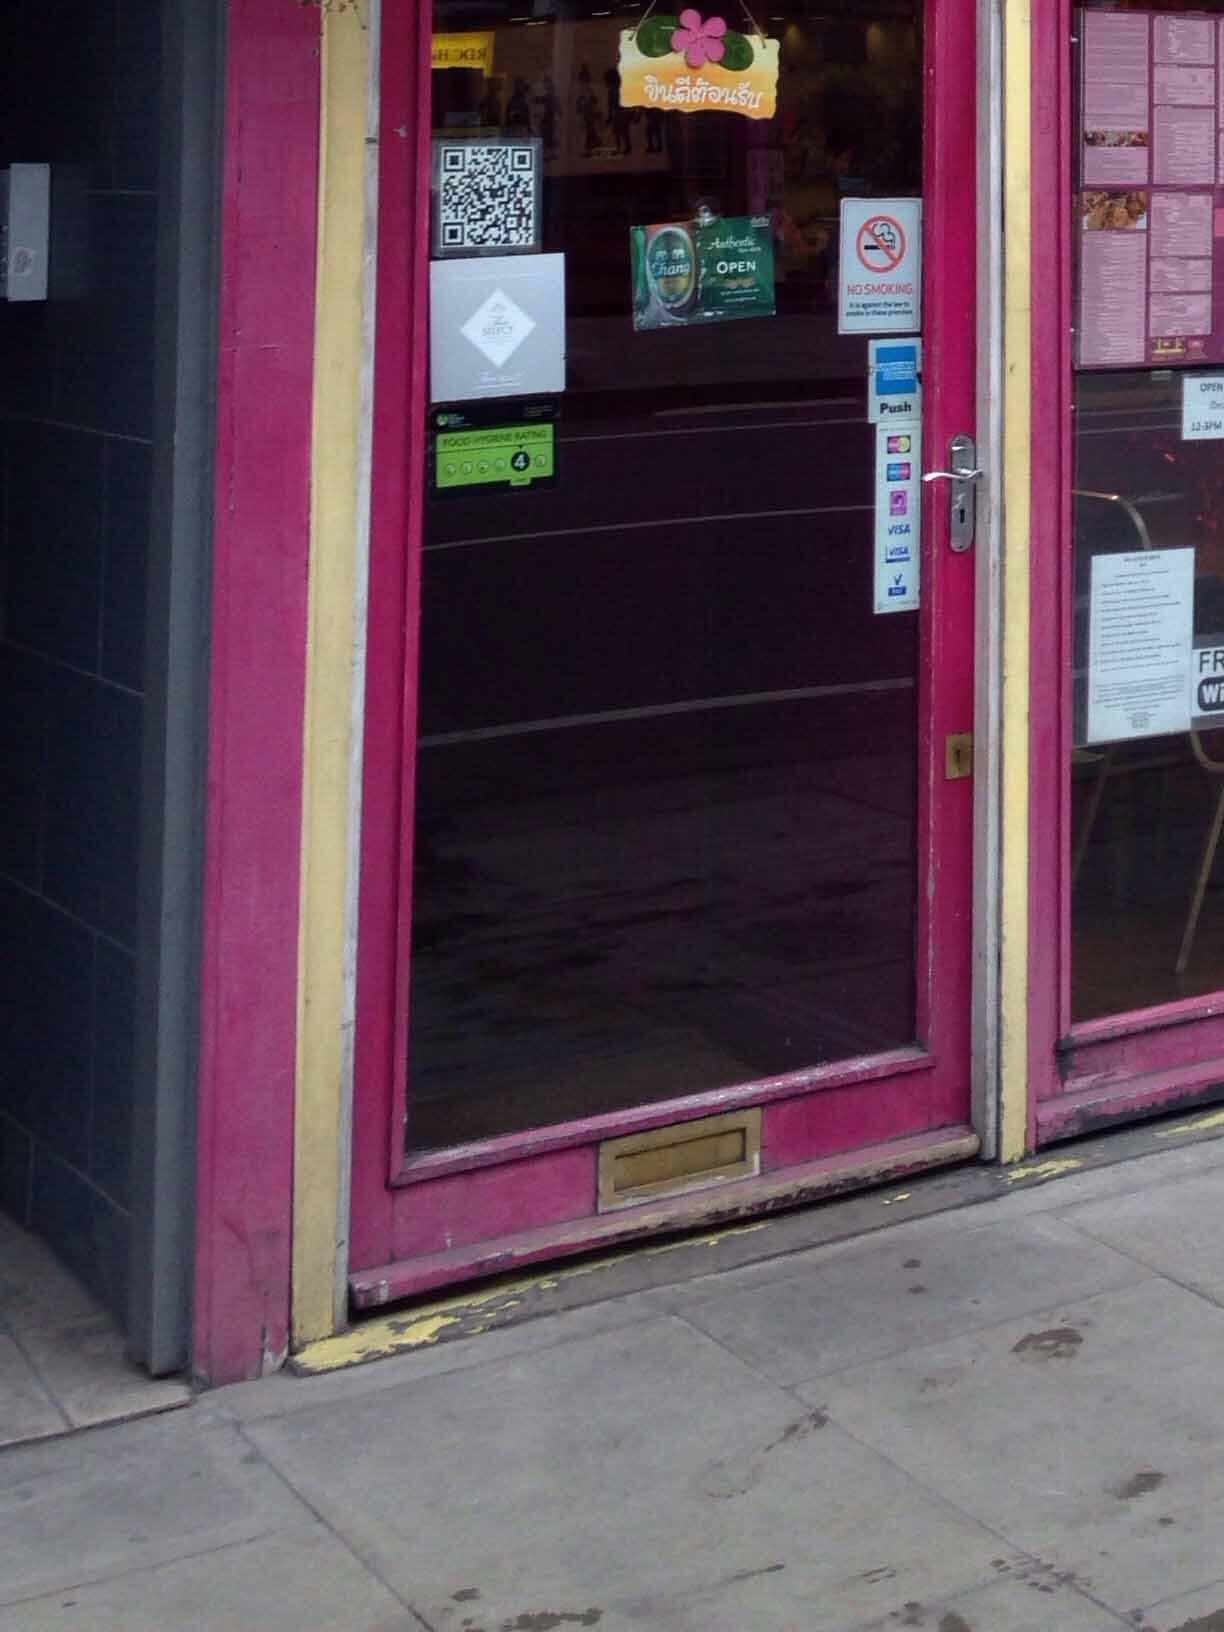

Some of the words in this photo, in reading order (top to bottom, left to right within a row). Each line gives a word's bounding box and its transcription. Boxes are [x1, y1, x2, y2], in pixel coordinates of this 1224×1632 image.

[716, 261, 756, 274] OPEN
[847, 283, 863, 296] NO
[864, 282, 913, 296] SMOKING
[1200, 382, 1223, 392] OPEN
[880, 402, 911, 415] Push
[442, 437, 471, 447] FOOD
[514, 429, 548, 439] RATING
[514, 453, 526, 469] 4
[888, 524, 911, 535] VISA
